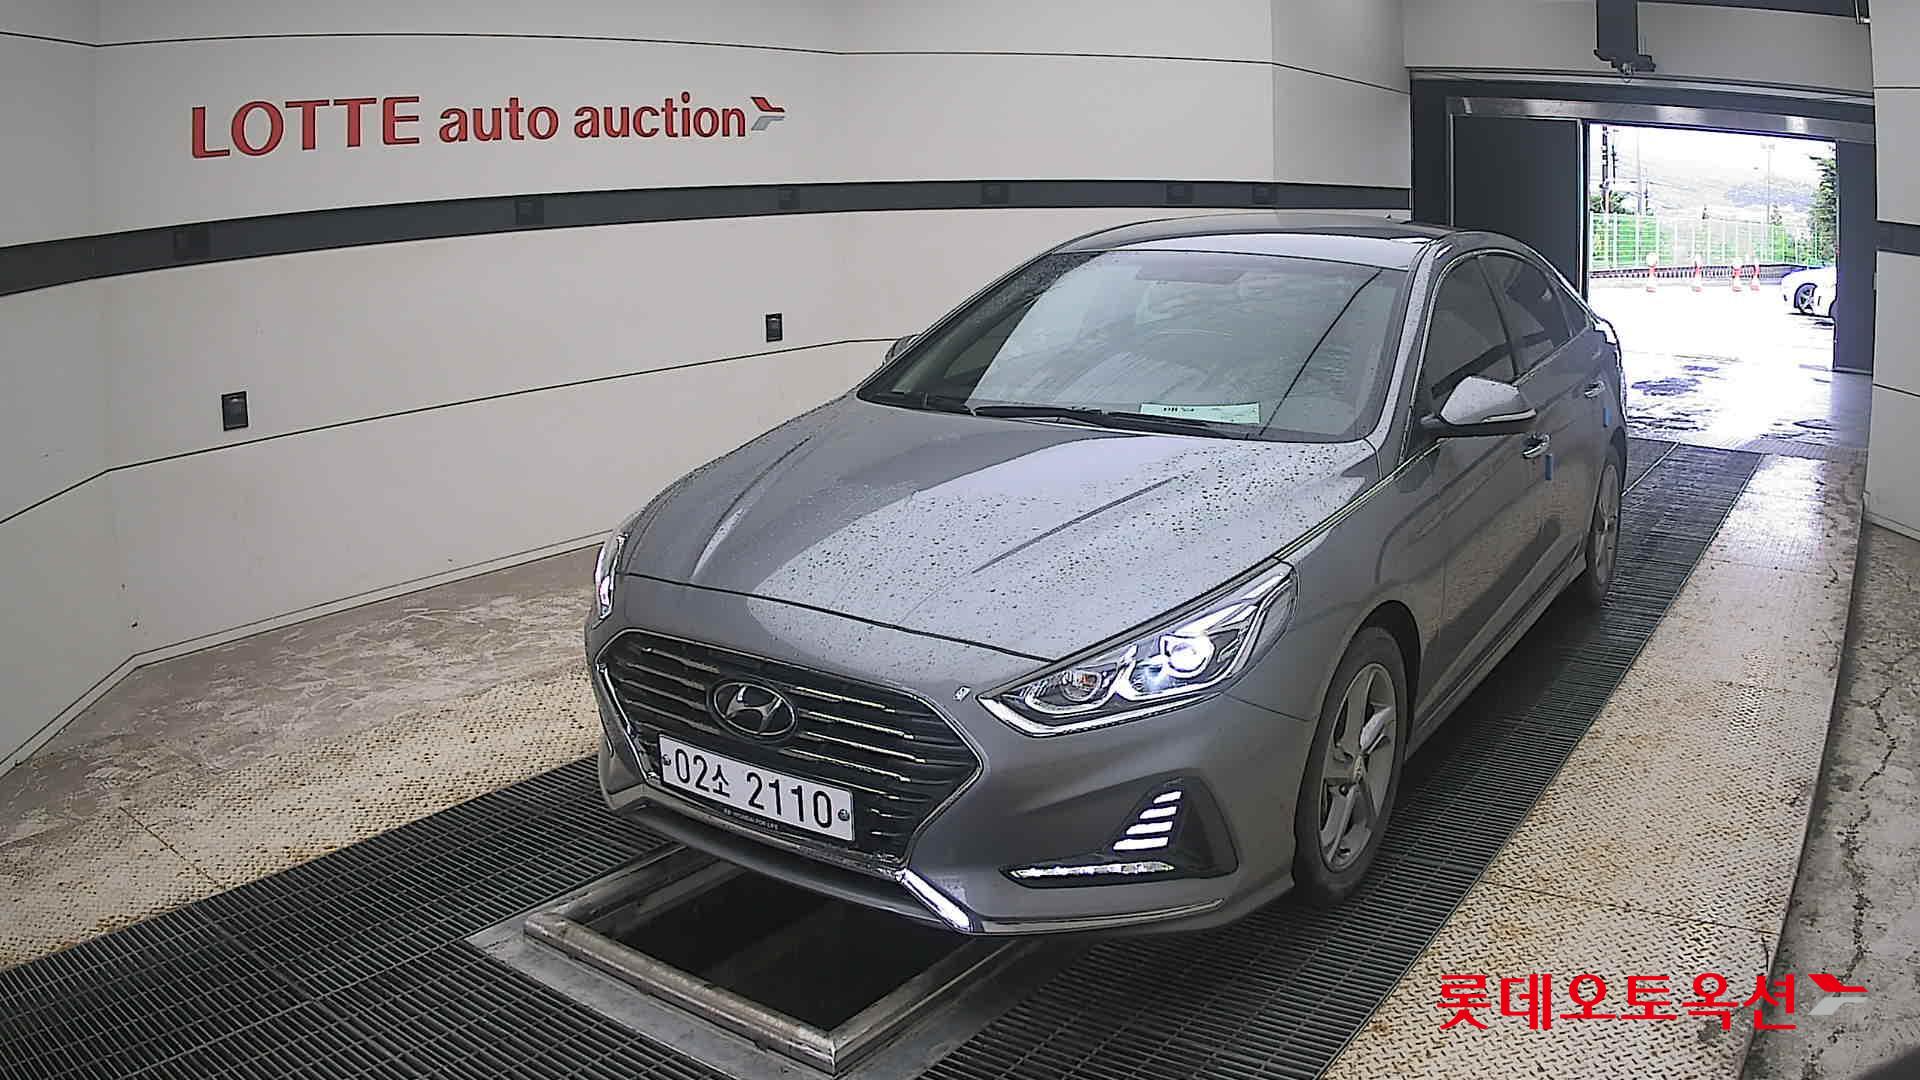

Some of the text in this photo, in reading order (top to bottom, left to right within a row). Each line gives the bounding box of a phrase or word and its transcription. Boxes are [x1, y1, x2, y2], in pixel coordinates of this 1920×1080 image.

[192, 91, 746, 159] LOTTE auto auction
[675, 749, 730, 798] 02소
[746, 772, 833, 828] 2110
